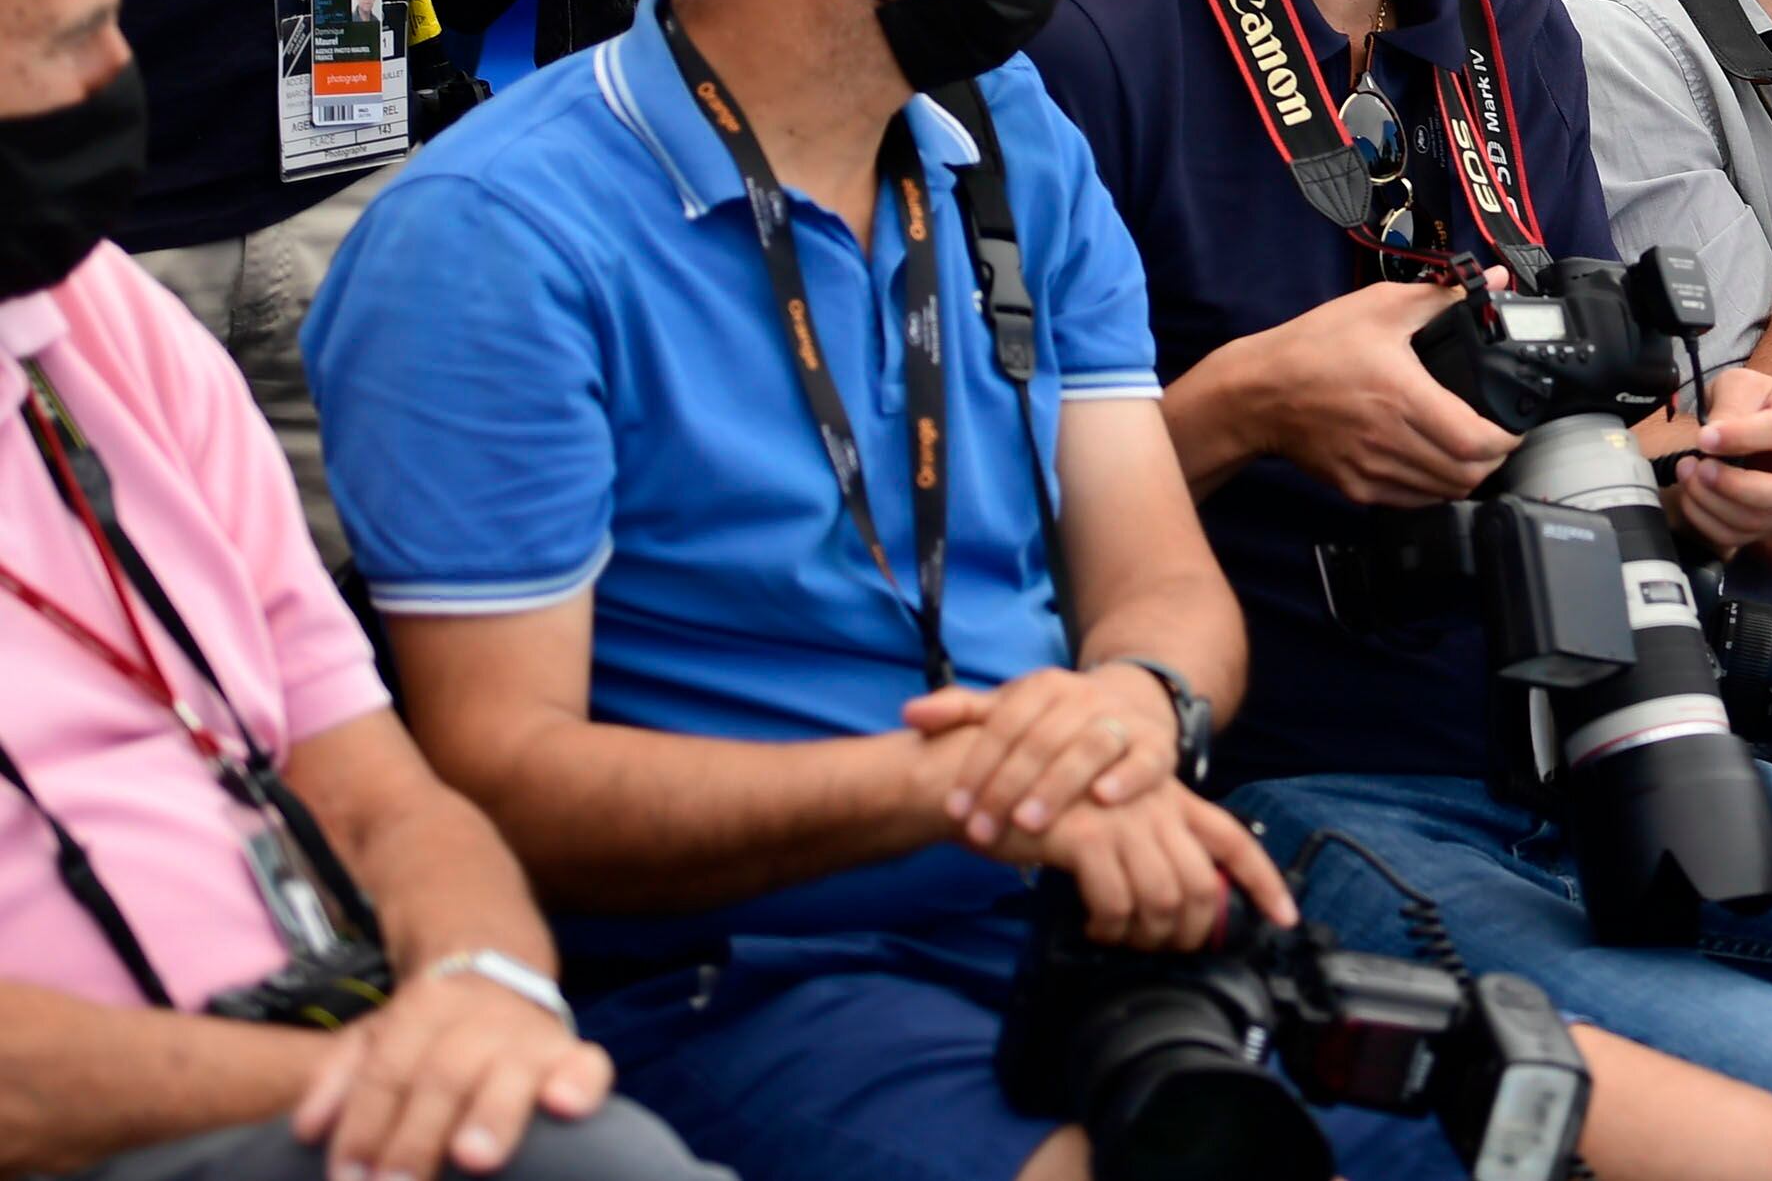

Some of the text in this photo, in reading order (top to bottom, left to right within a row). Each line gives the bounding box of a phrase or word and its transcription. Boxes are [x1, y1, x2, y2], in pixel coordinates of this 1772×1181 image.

[1468, 48, 1488, 73] IV
[326, 73, 368, 85] photographe
[1476, 76, 1502, 134] Mark
[324, 145, 369, 160] Photographe
[1451, 118, 1502, 214] EOS
